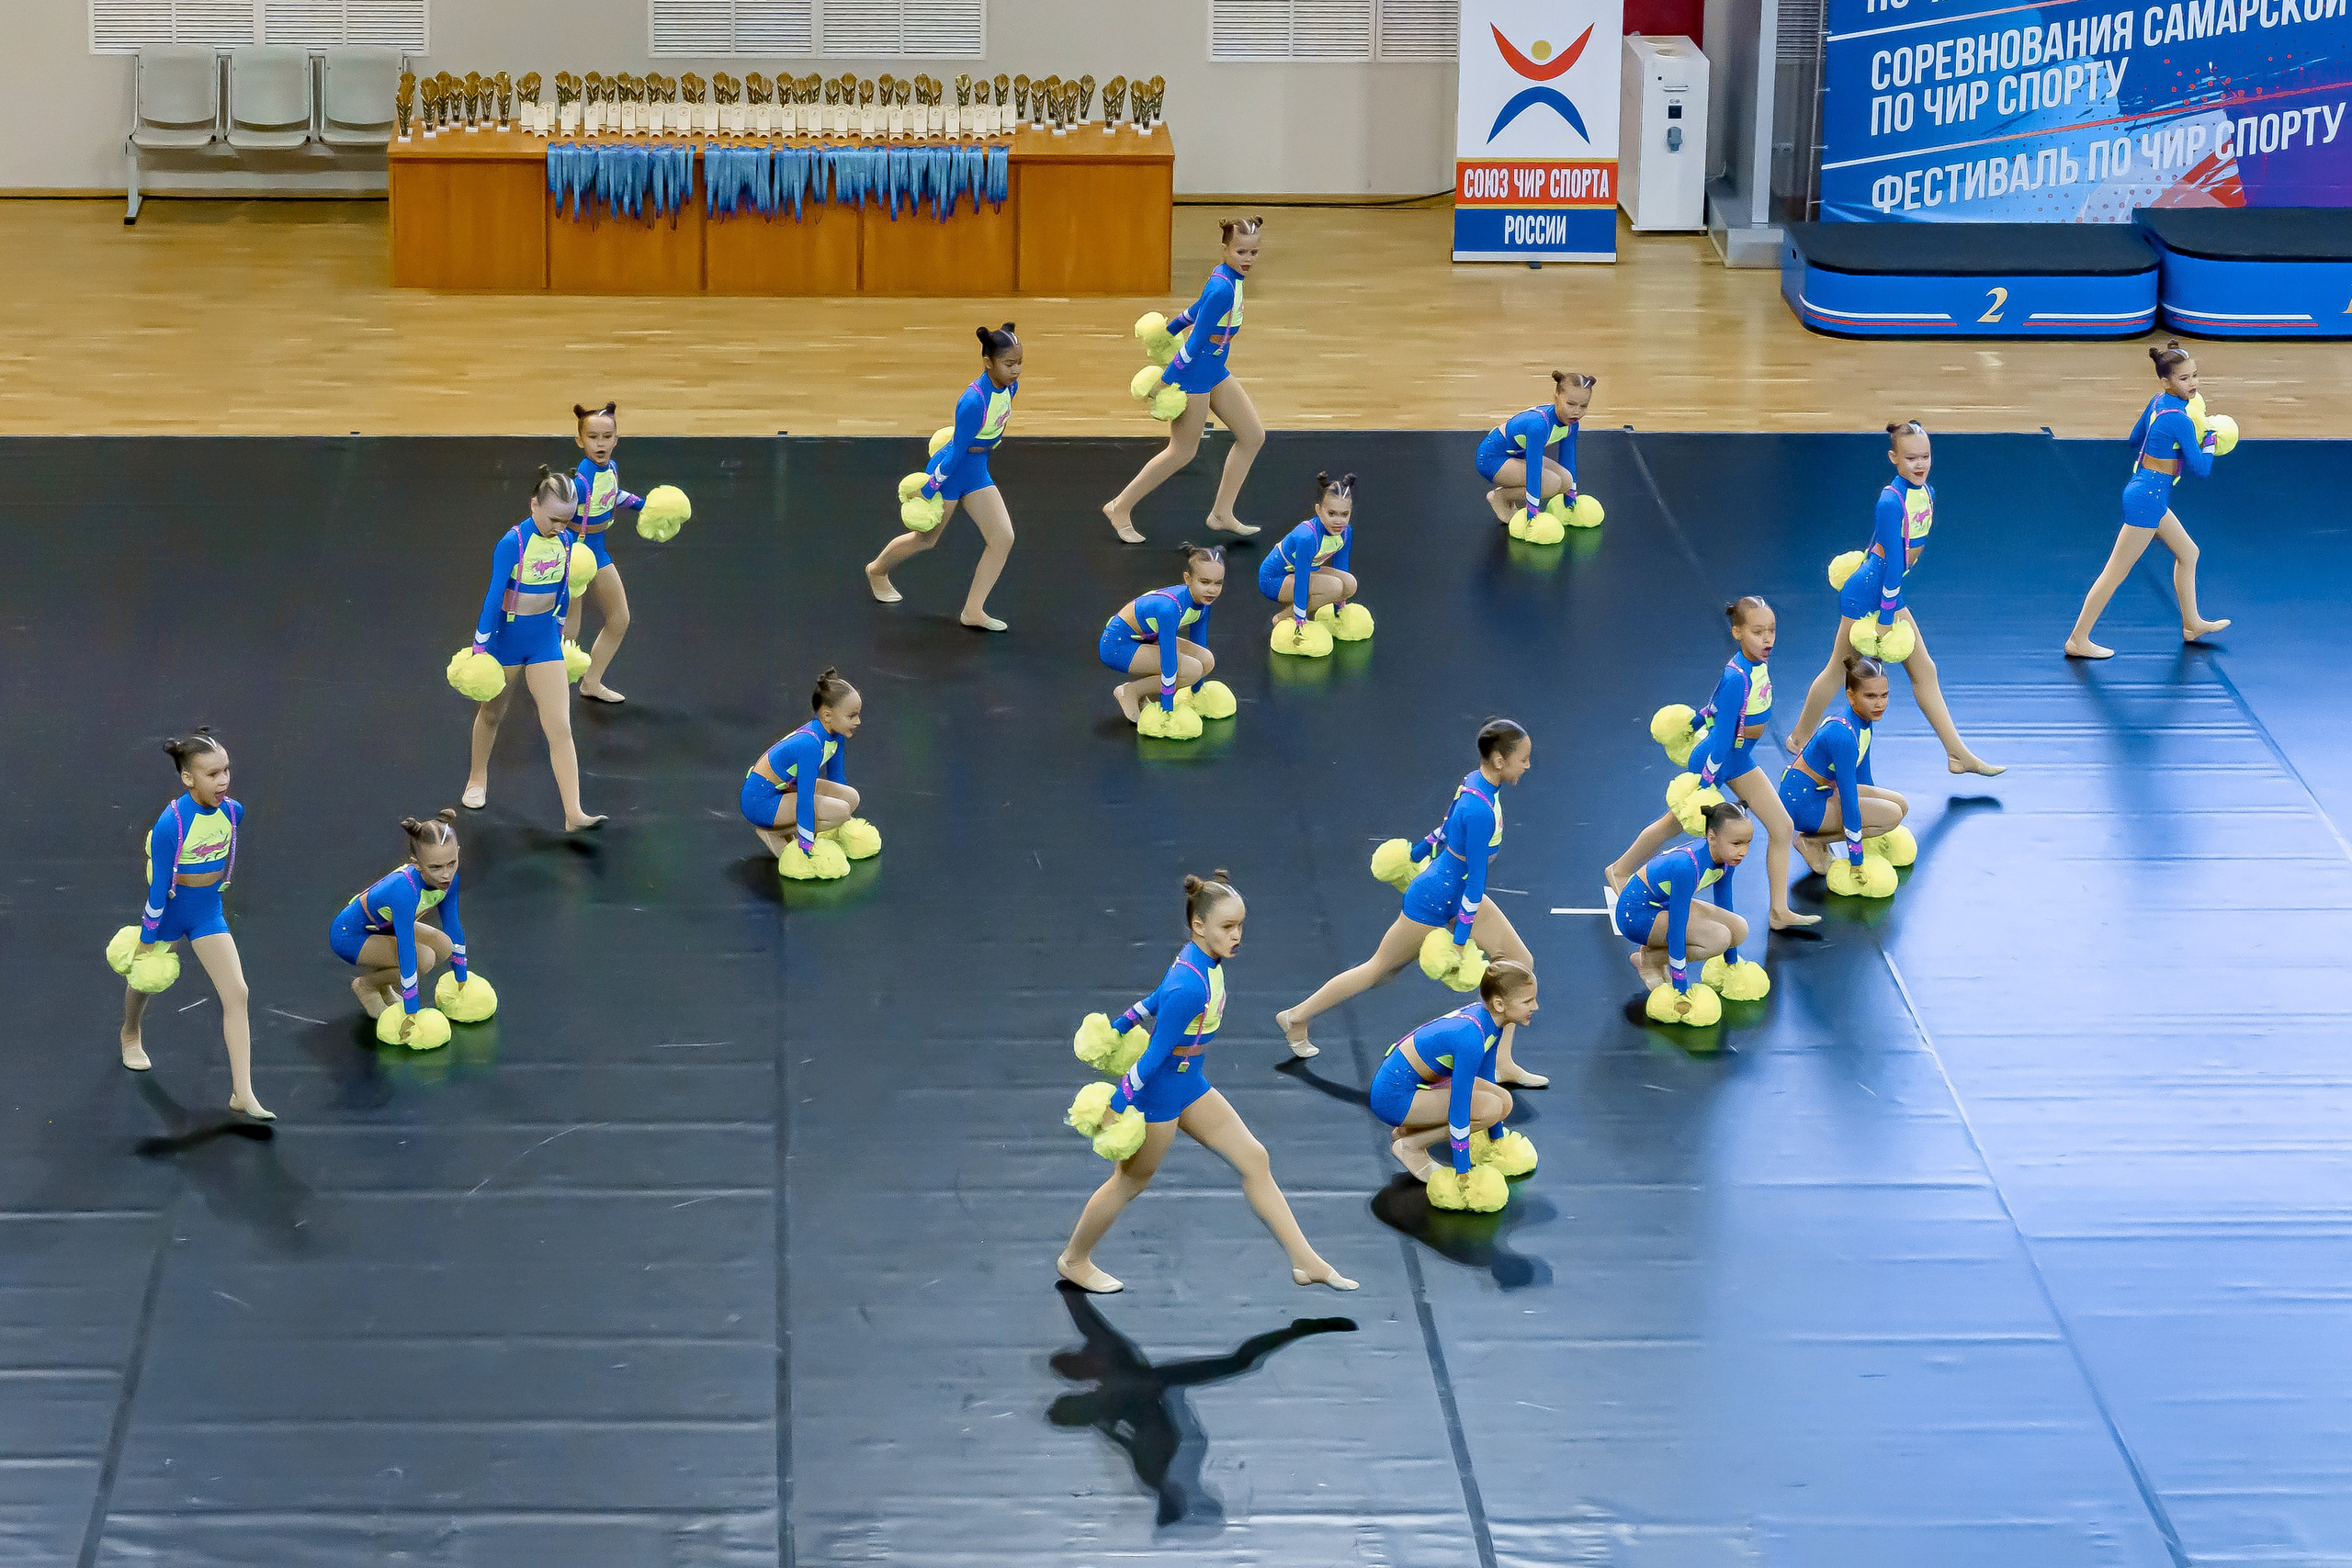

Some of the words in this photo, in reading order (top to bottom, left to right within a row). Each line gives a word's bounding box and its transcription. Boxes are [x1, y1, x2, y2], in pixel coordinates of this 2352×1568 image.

[1871, 11, 2133, 90] СОРЕВНОВАНИЯ
[1871, 96, 1915, 136] ПО
[1924, 80, 1987, 127] ЧИР
[1997, 57, 2129, 115] СПОРТУ
[1464, 168, 1509, 198] СОЮЗ
[1513, 168, 1544, 198] ЧИР
[1550, 168, 1609, 198] СПОРТА
[1871, 147, 2079, 214] ФЕСТИВАЛЬ
[2089, 137, 2131, 180] ПО
[2141, 123, 2205, 171] ЧИР
[2215, 103, 2346, 160] СПОРТУ
[1504, 215, 1567, 245] РОССИИ
[1976, 287, 2008, 322] 2
